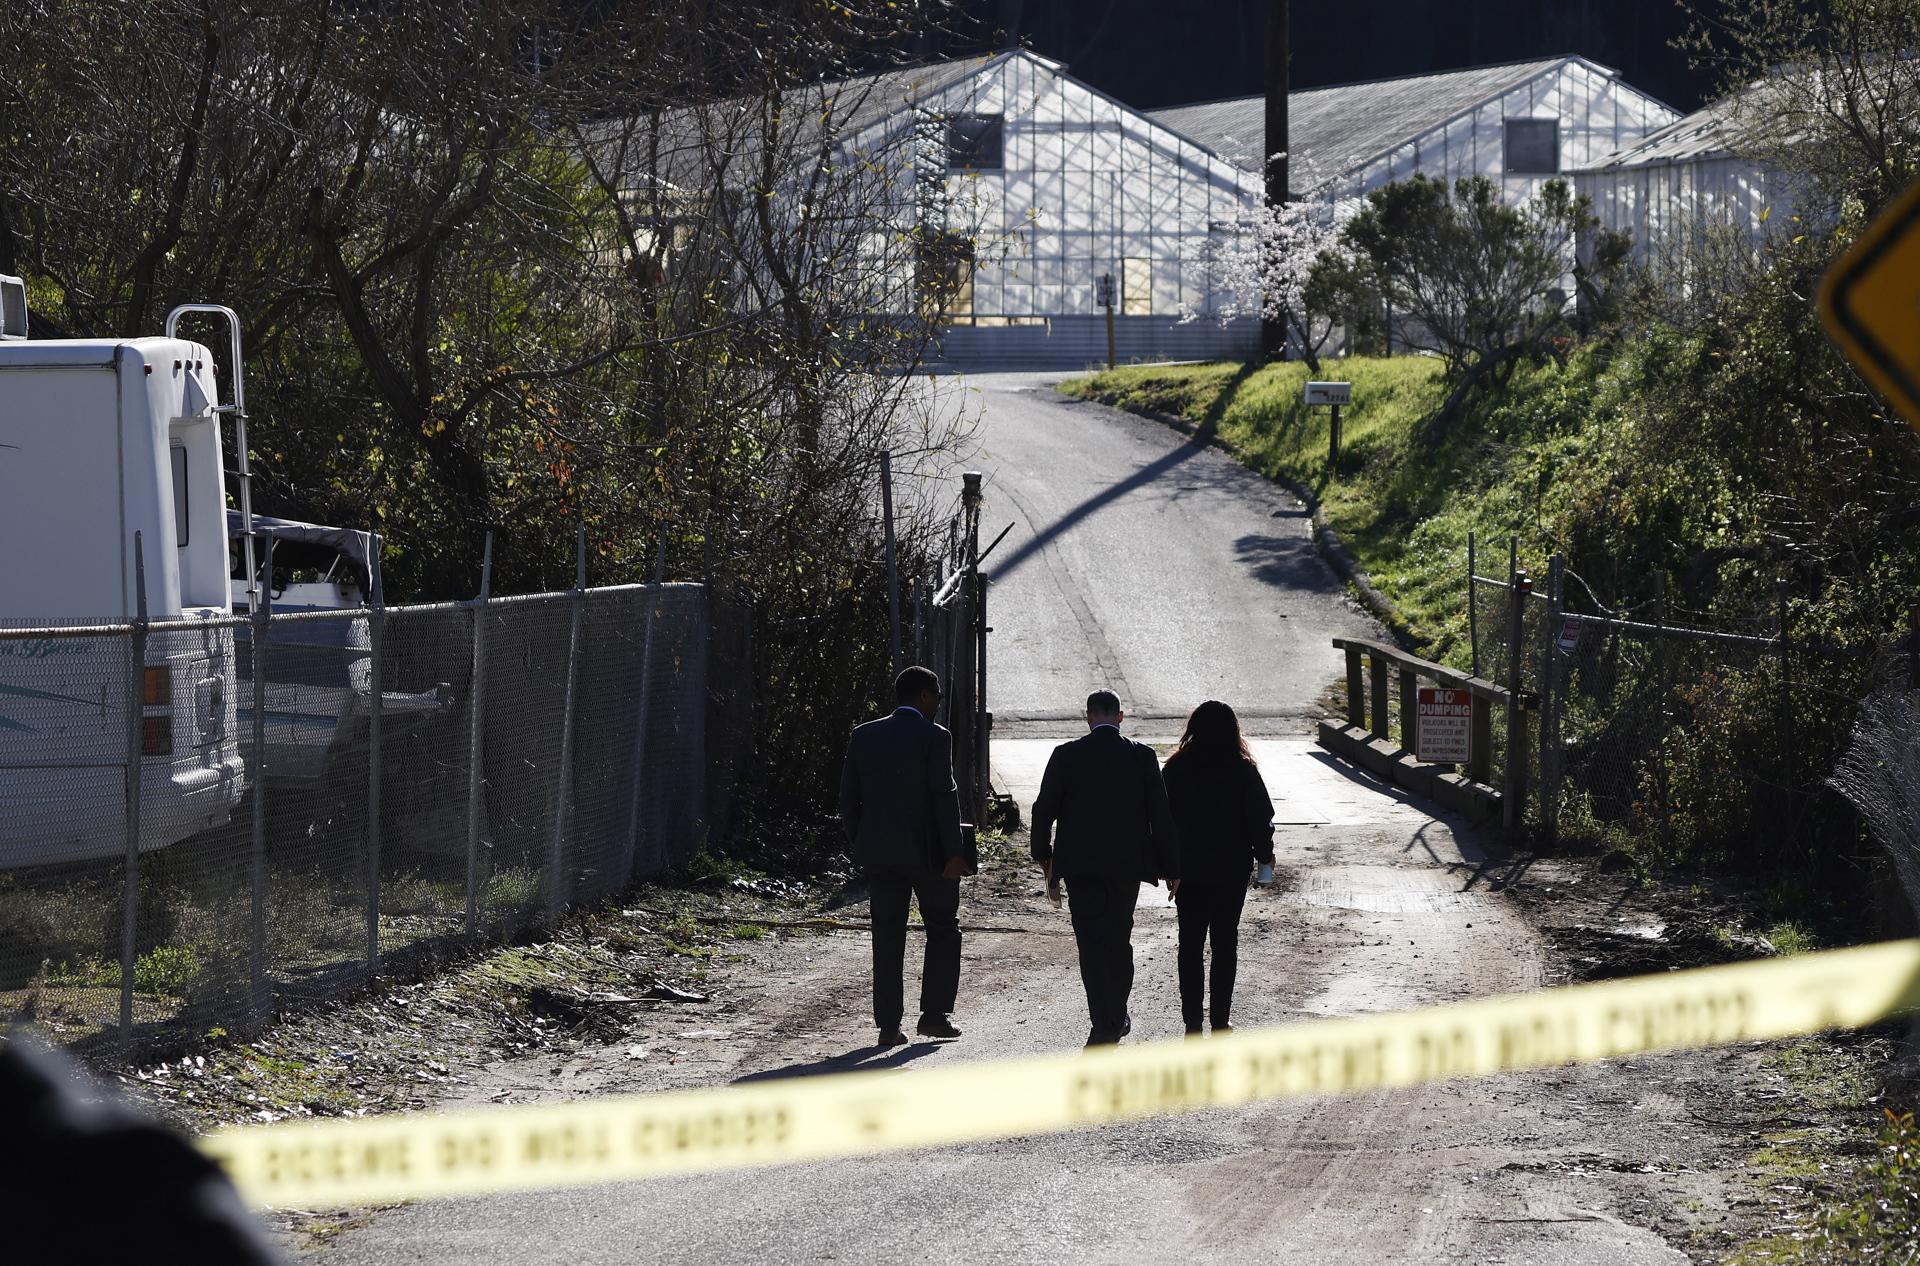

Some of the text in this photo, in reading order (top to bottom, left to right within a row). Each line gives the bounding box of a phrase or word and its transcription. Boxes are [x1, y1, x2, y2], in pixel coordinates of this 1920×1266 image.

[1434, 691, 1454, 704] NO
[1420, 704, 1470, 715] DUMPING
[1421, 719, 1447, 727] VIOLATORS
[1423, 728, 1454, 736] PROSECUTED
[1422, 737, 1443, 745] SUBJECT
[1432, 747, 1467, 755] IMPRISONMENT
